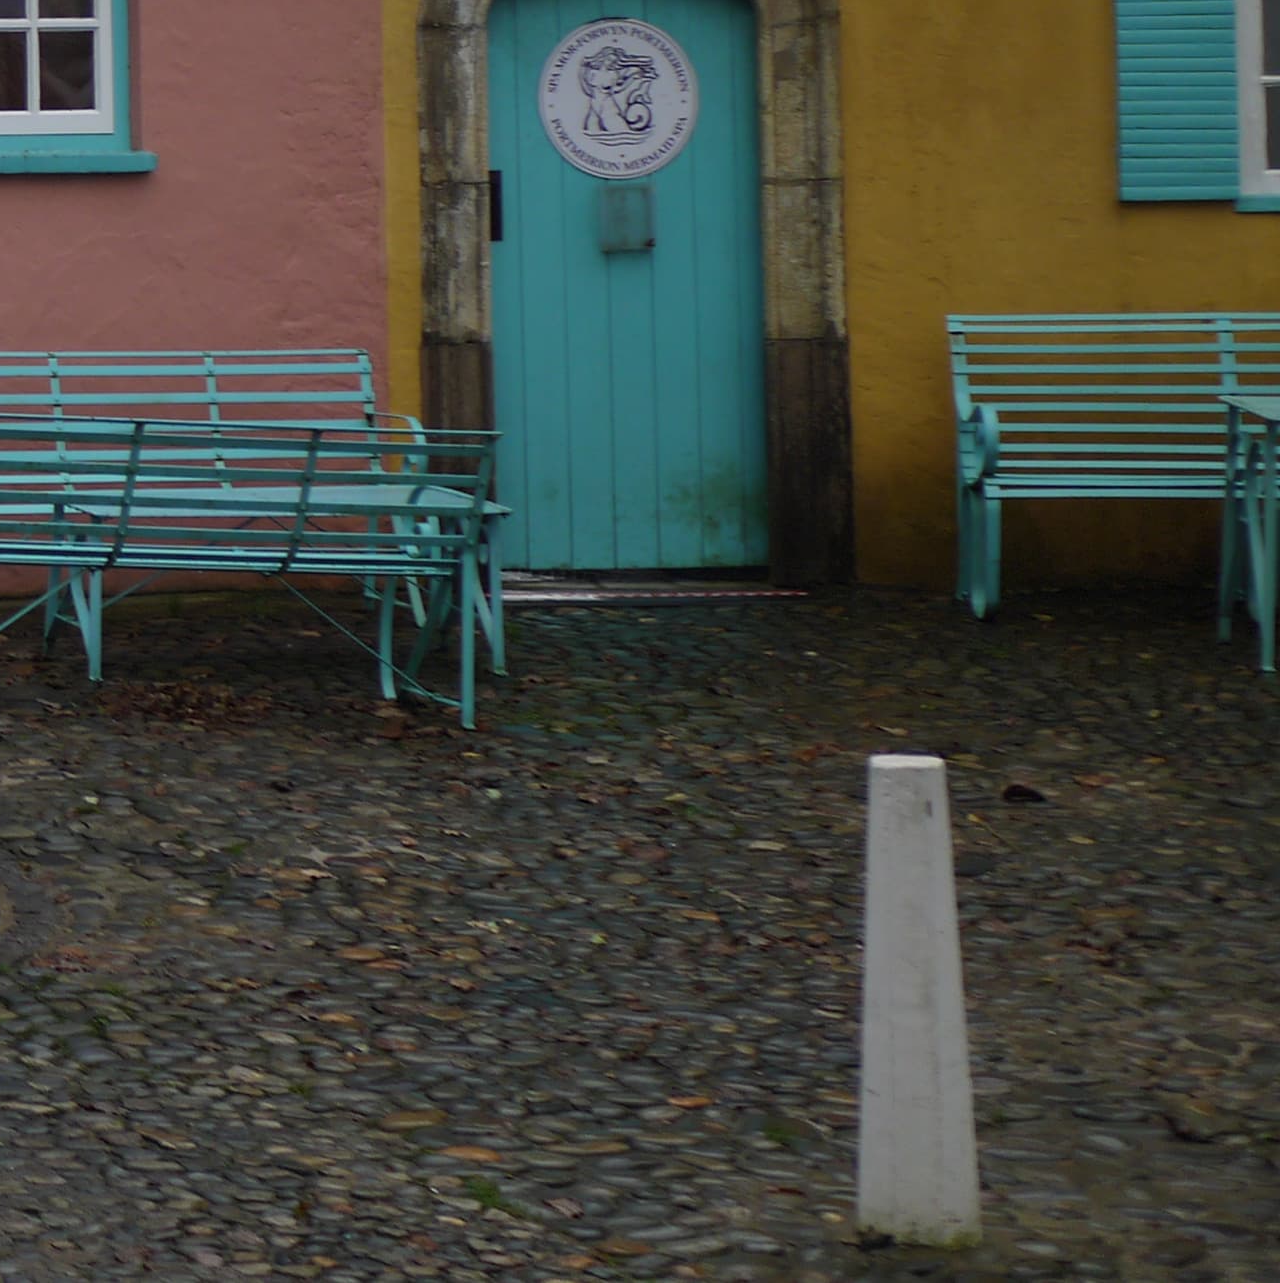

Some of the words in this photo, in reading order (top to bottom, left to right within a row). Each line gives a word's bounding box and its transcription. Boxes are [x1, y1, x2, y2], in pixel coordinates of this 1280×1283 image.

[547, 72, 561, 94] SPA
[622, 137, 676, 170] MERMAID
[674, 116, 689, 137] SPA
